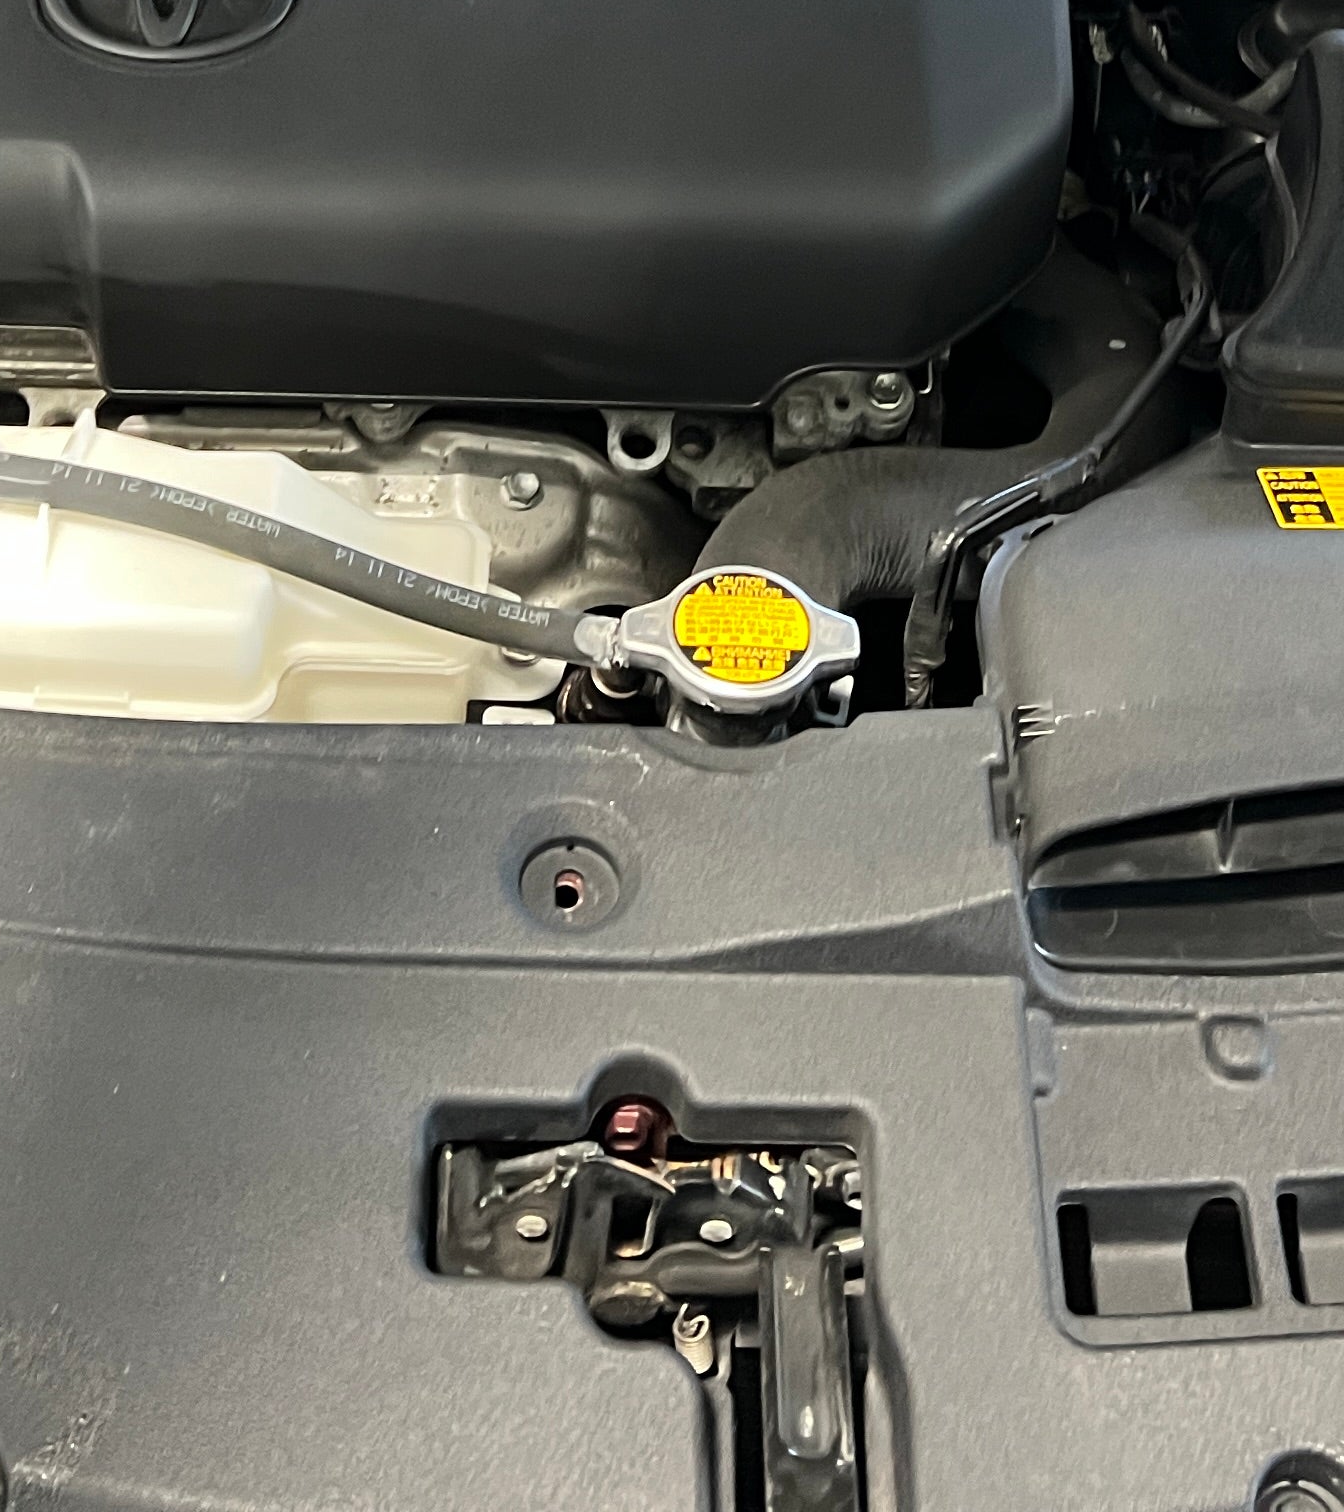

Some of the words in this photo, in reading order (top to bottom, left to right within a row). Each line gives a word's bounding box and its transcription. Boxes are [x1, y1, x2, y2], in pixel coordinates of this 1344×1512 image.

[50, 462, 73, 480] 14
[118, 479, 141, 494] 21
[226, 510, 281, 539] WATER
[334, 546, 356, 567] 14
[396, 569, 418, 588] 21
[713, 575, 767, 589] CAUTION
[714, 586, 783, 599] ATTENTION
[498, 602, 551, 629] WATER
[711, 646, 791, 662] ВНИМАНИЕ!
